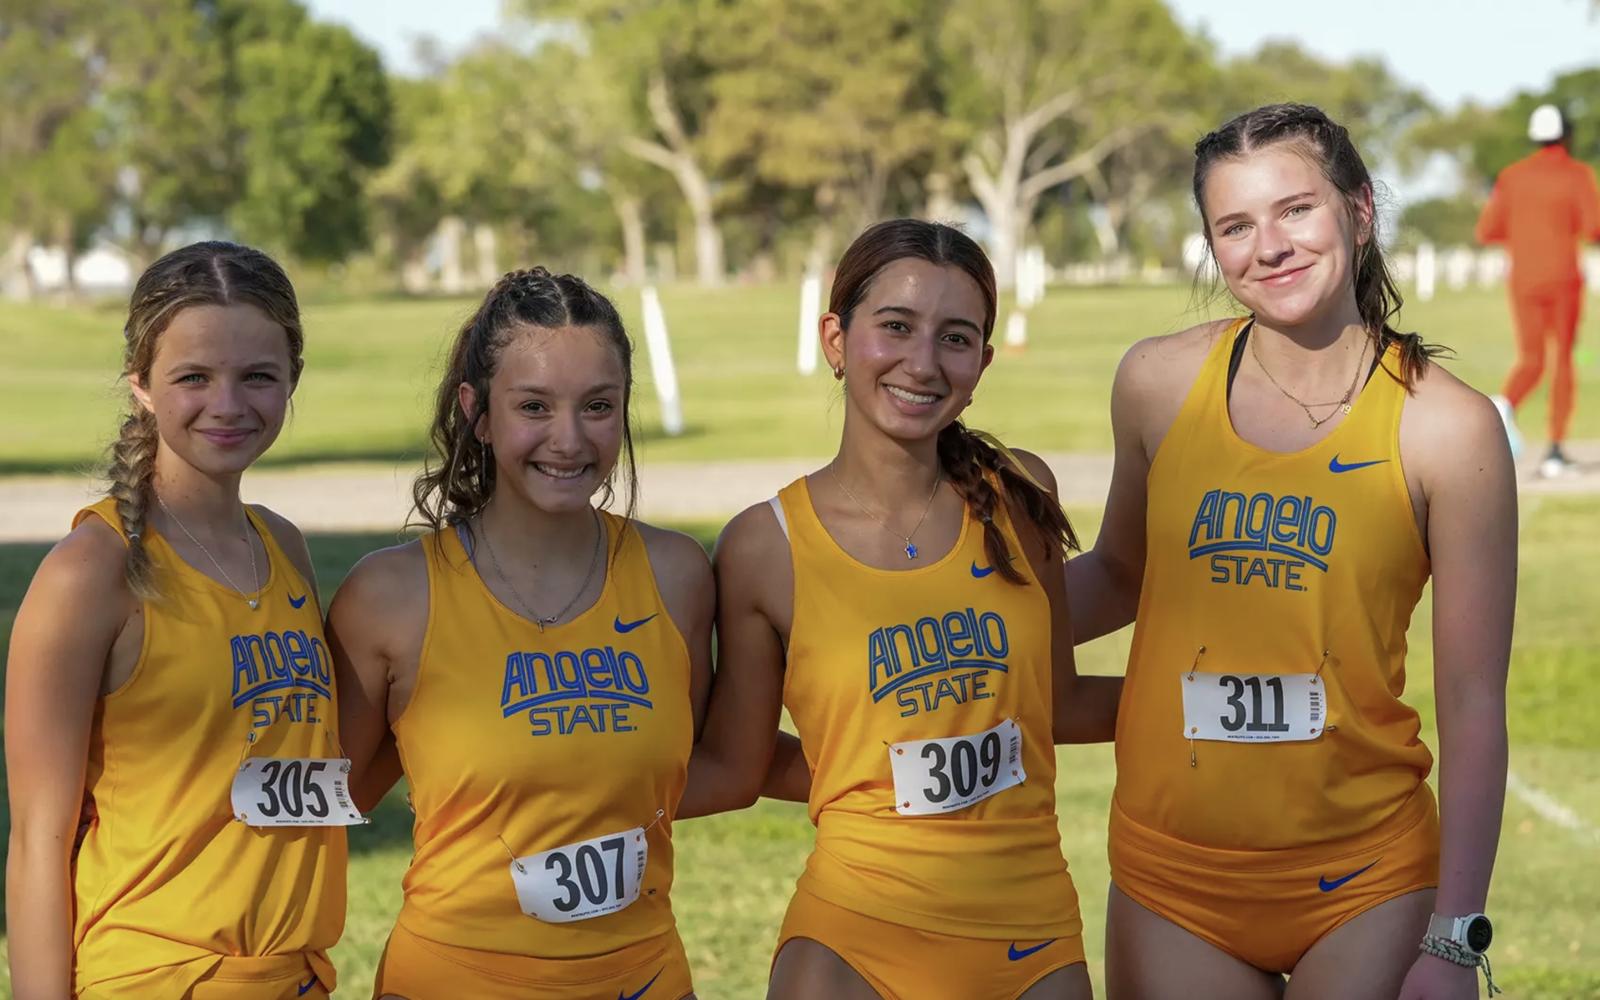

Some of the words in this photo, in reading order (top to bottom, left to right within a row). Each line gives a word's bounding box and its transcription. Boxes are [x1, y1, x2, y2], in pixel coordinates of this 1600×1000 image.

[1188, 489, 1336, 560] Angelo
[230, 630, 332, 706] Angelo
[500, 646, 652, 716] Angelo
[869, 607, 1009, 704] Angelo
[1219, 675, 1290, 732] 311
[257, 760, 330, 818] 305
[920, 731, 1002, 803] 309
[545, 836, 625, 912] 307
